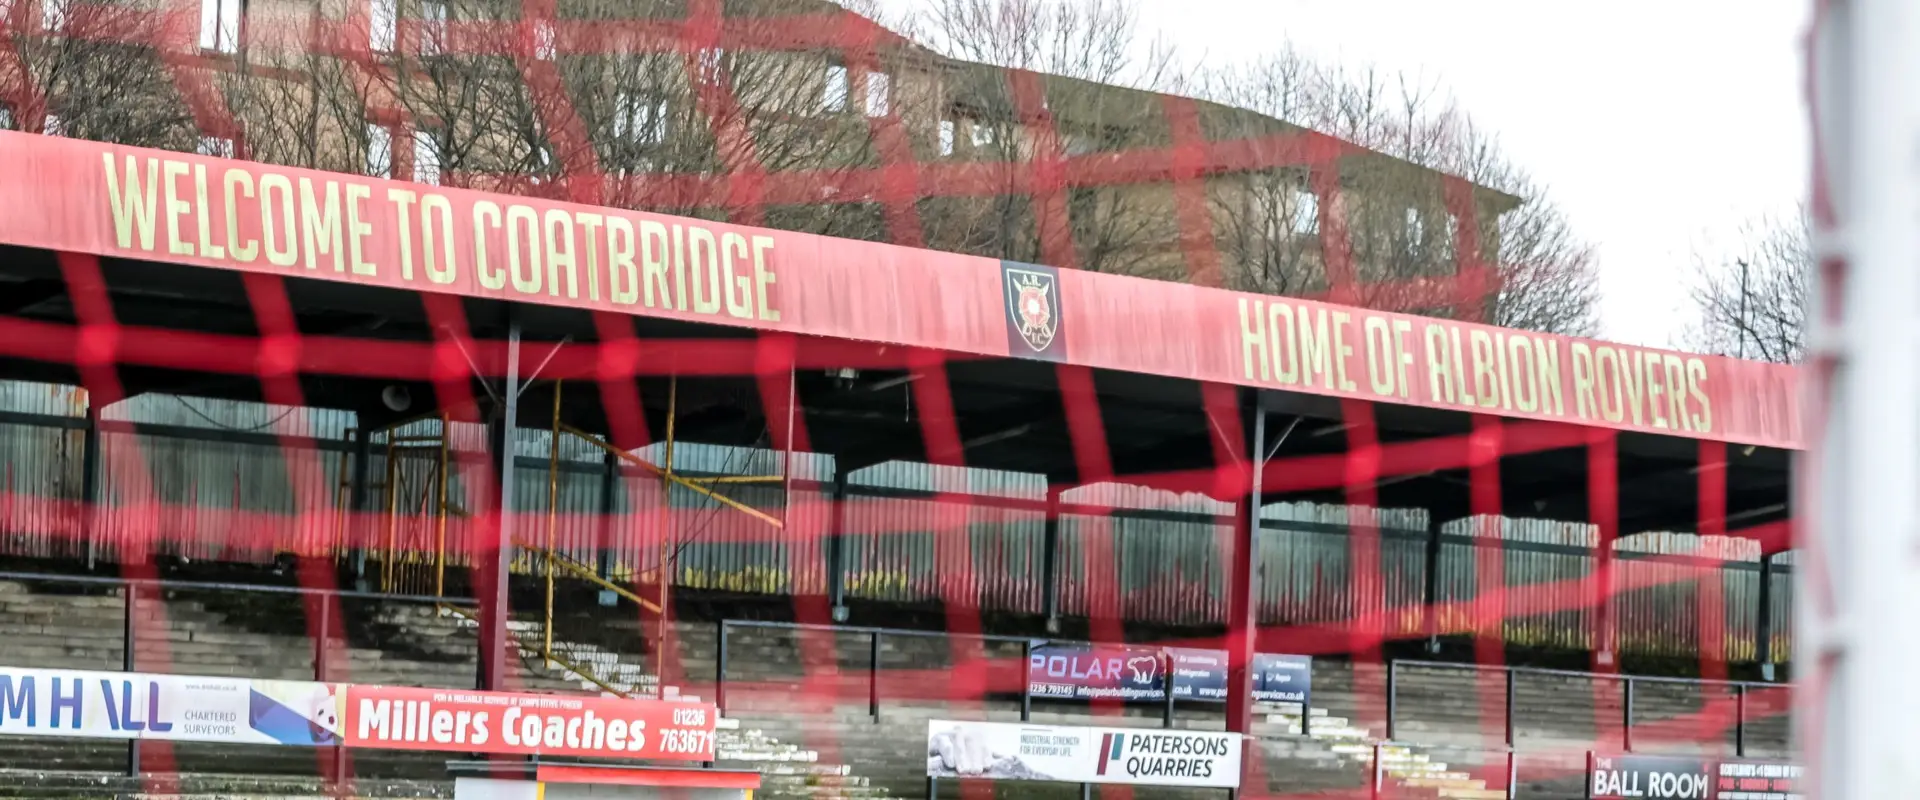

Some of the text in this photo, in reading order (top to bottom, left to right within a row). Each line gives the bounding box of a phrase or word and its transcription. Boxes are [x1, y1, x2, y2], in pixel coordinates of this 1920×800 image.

[102, 152, 781, 322] WELCOME TO COATBRIDGE
[1238, 298, 1712, 433] HOME OF ALBION ROVERS
[1031, 655, 1123, 680] POLAR
[184, 710, 237, 722] CHARTERED
[358, 698, 646, 752] Millers Coaches
[673, 708, 705, 725] 01236
[184, 723, 236, 735] SURVEYORS
[659, 729, 714, 755] 763671
[1130, 734, 1228, 757] PATERSONS
[1126, 757, 1213, 778] QUARRIES
[1594, 770, 1643, 796] BALL
[1648, 771, 1709, 800] ROOM
